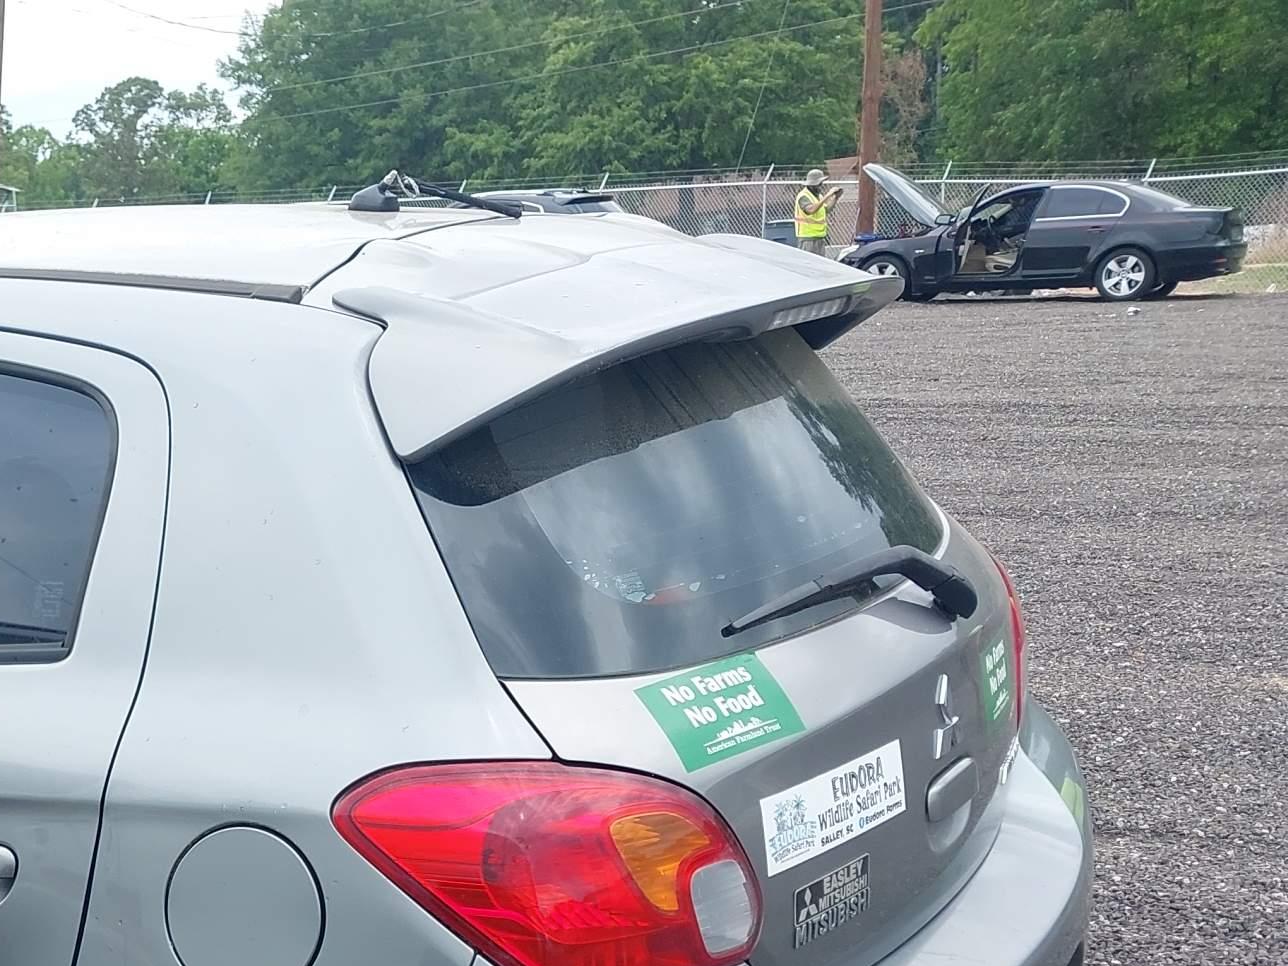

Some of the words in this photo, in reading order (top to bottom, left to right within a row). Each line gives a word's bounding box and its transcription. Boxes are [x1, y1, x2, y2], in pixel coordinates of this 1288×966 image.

[660, 684, 696, 706] No
[690, 666, 753, 696] Farms
[684, 705, 718, 729] No
[712, 684, 765, 717] Food
[706, 739, 736, 755] American
[735, 728, 764, 746] Farmland
[764, 722, 782, 736] Trust
[831, 756, 885, 802] EUDORA
[817, 799, 854, 832] Wildlife
[855, 785, 882, 814] Safari
[883, 776, 902, 801] Park
[865, 808, 886, 825] Eudora
[886, 799, 903, 814] Farms
[820, 828, 845, 847] SALLEY,
[845, 823, 854, 835] SC
[818, 873, 869, 912] MITSUBISHI
[823, 859, 864, 895] EASLEY
[794, 887, 871, 950] MITSUBISHI
